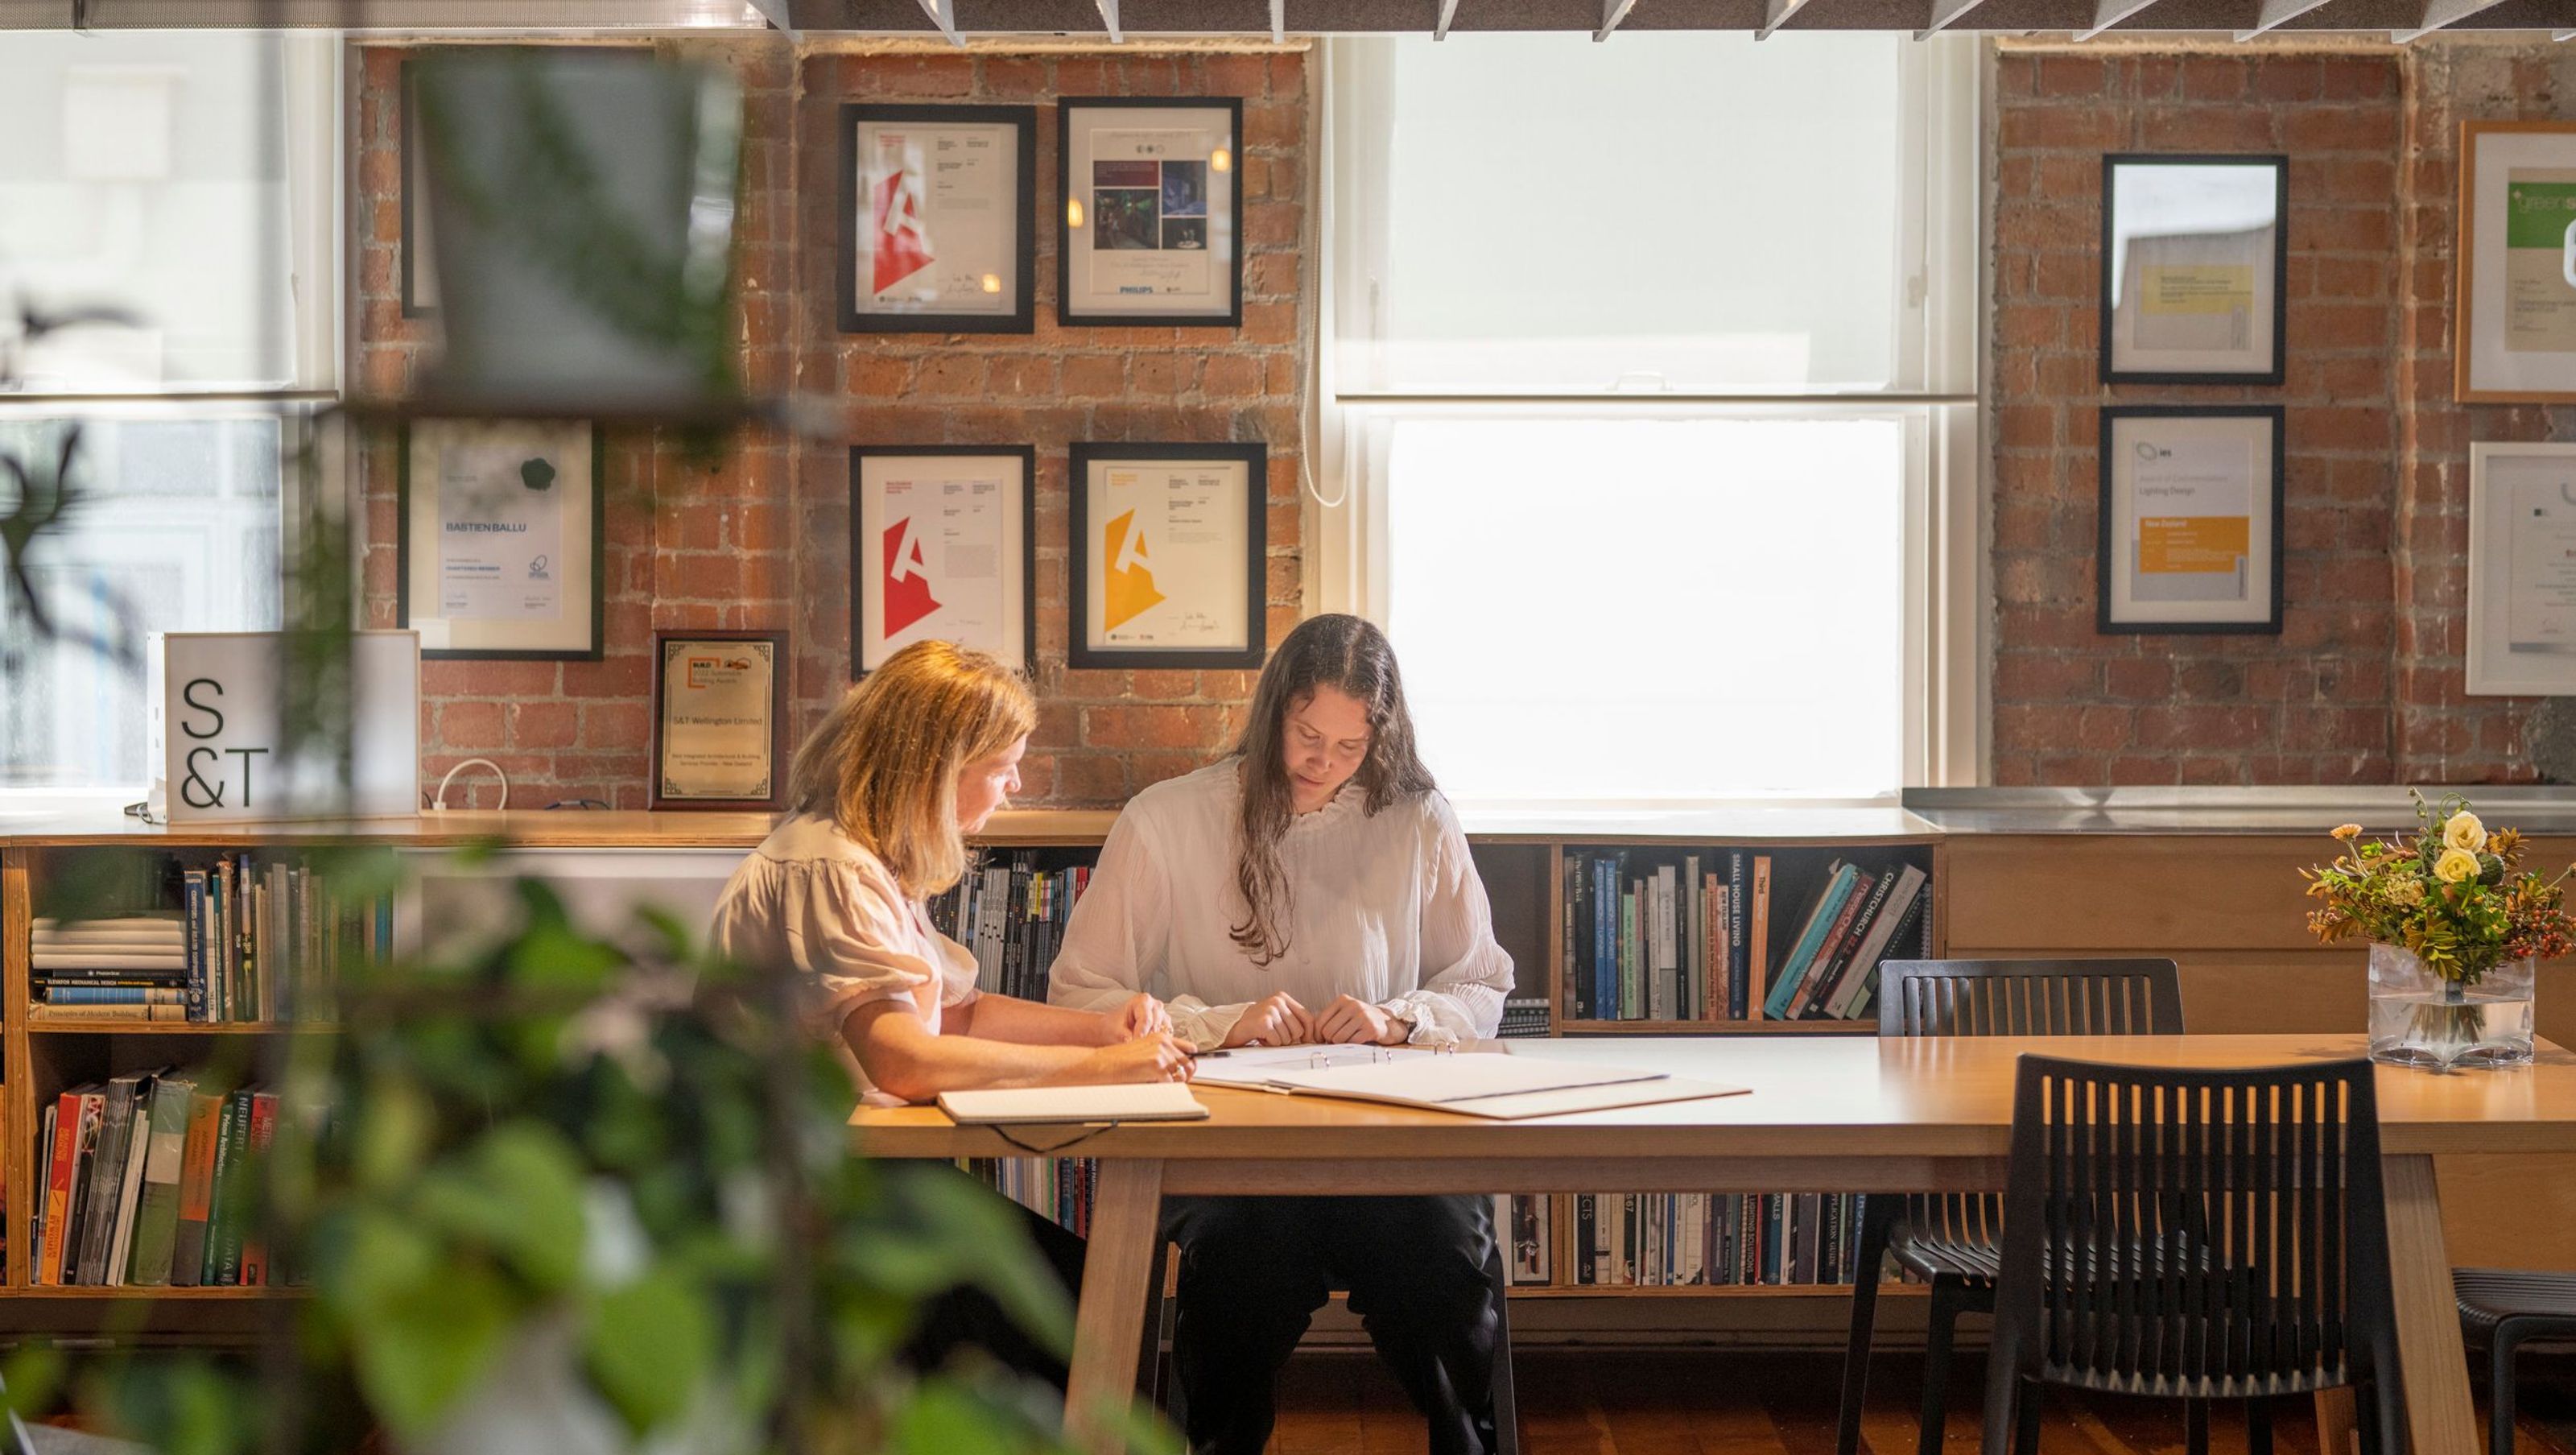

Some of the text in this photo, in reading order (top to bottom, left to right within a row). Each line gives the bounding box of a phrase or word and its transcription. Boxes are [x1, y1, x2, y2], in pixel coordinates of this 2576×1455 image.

[1119, 286, 1154, 294] PHILIPS
[2139, 487, 2169, 496] Lighting
[446, 523, 526, 533] BASTIEN BALLU
[181, 678, 224, 739] S
[691, 716, 733, 727] Wellington
[181, 746, 269, 808] &T
[1732, 854, 1740, 883] SMALL
[1732, 884, 1740, 915] HOUSE
[1758, 877, 1766, 895] Third
[1853, 872, 1894, 936] CHRISTCHURCH
[1732, 916, 1740, 947] LIVING
[48, 1010, 78, 1019] Principles
[78, 1010, 86, 1018] of
[86, 1010, 110, 1018] Modern
[216, 1114, 231, 1178] Prison Architecture
[1829, 1193, 1838, 1238] PPLICATION
